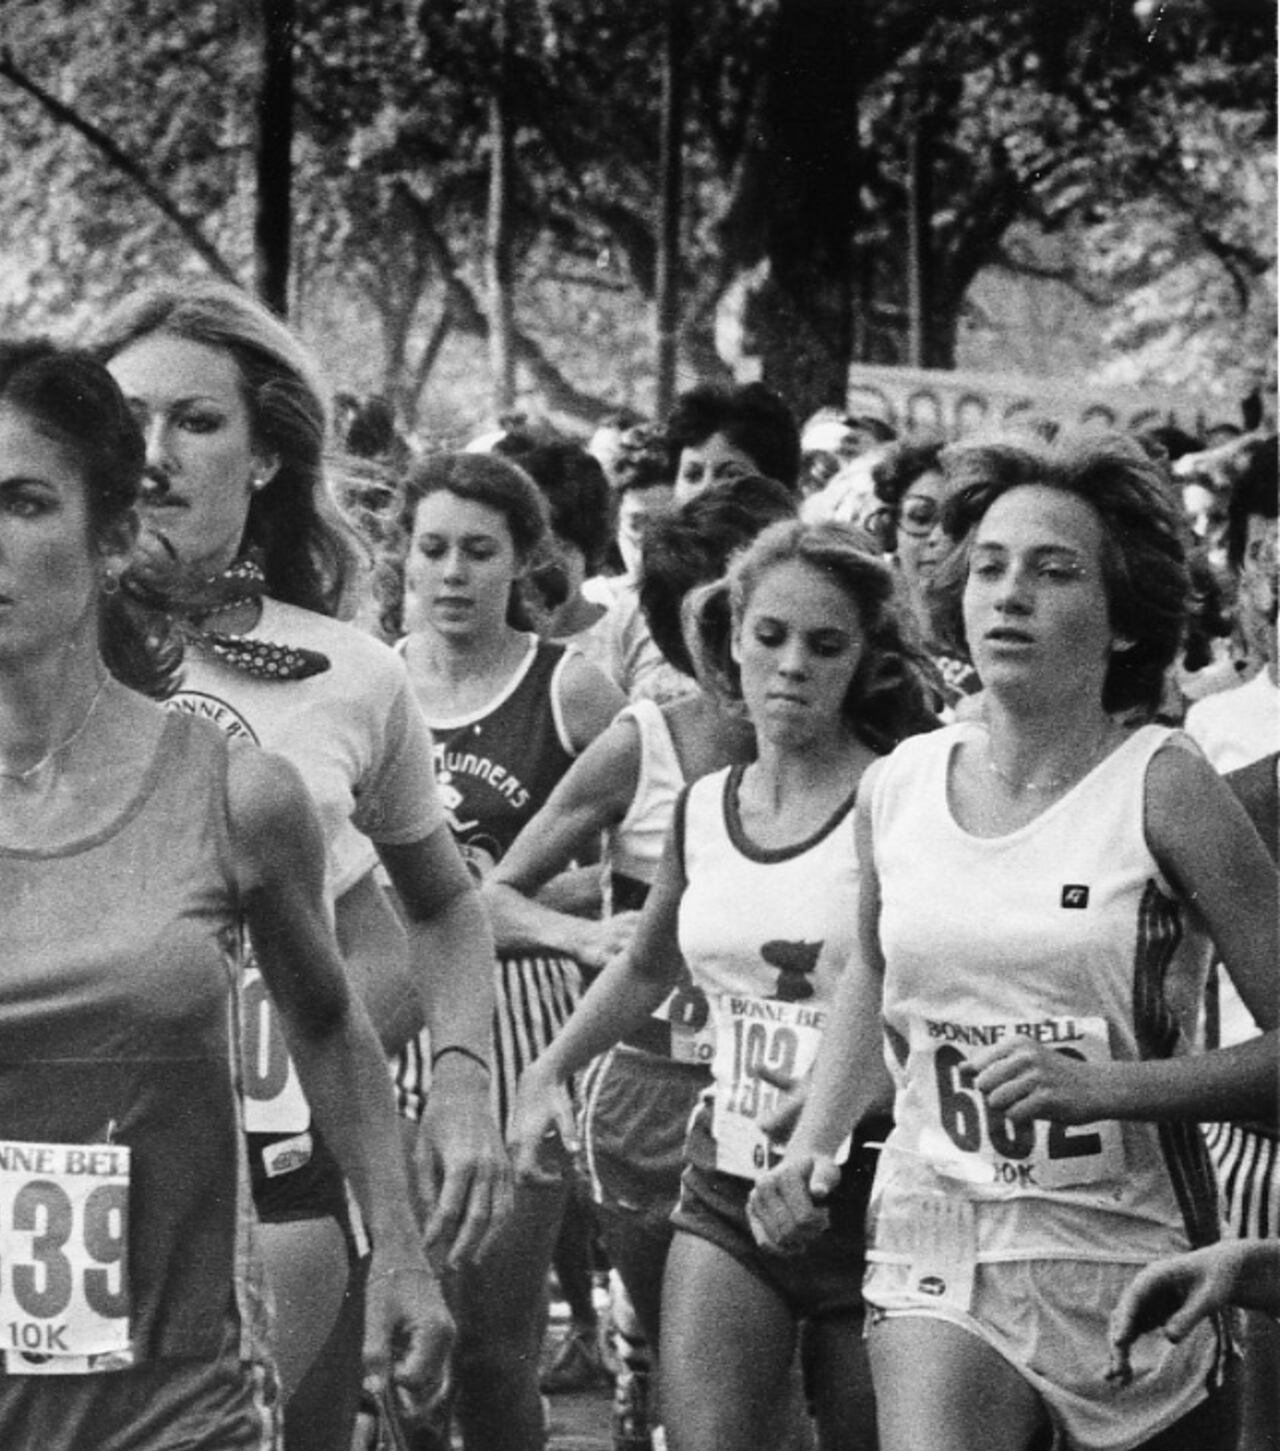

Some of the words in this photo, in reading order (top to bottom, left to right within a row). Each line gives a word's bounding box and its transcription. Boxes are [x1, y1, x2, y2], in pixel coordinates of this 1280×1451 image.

[165, 699, 229, 722] ONNE
[795, 1008, 828, 1031] BE
[926, 1019, 1006, 1046] BONNE
[1015, 1020, 1087, 1044] BELL
[64, 1150, 128, 1176] BEL
[7, 1320, 69, 1351] 10K
